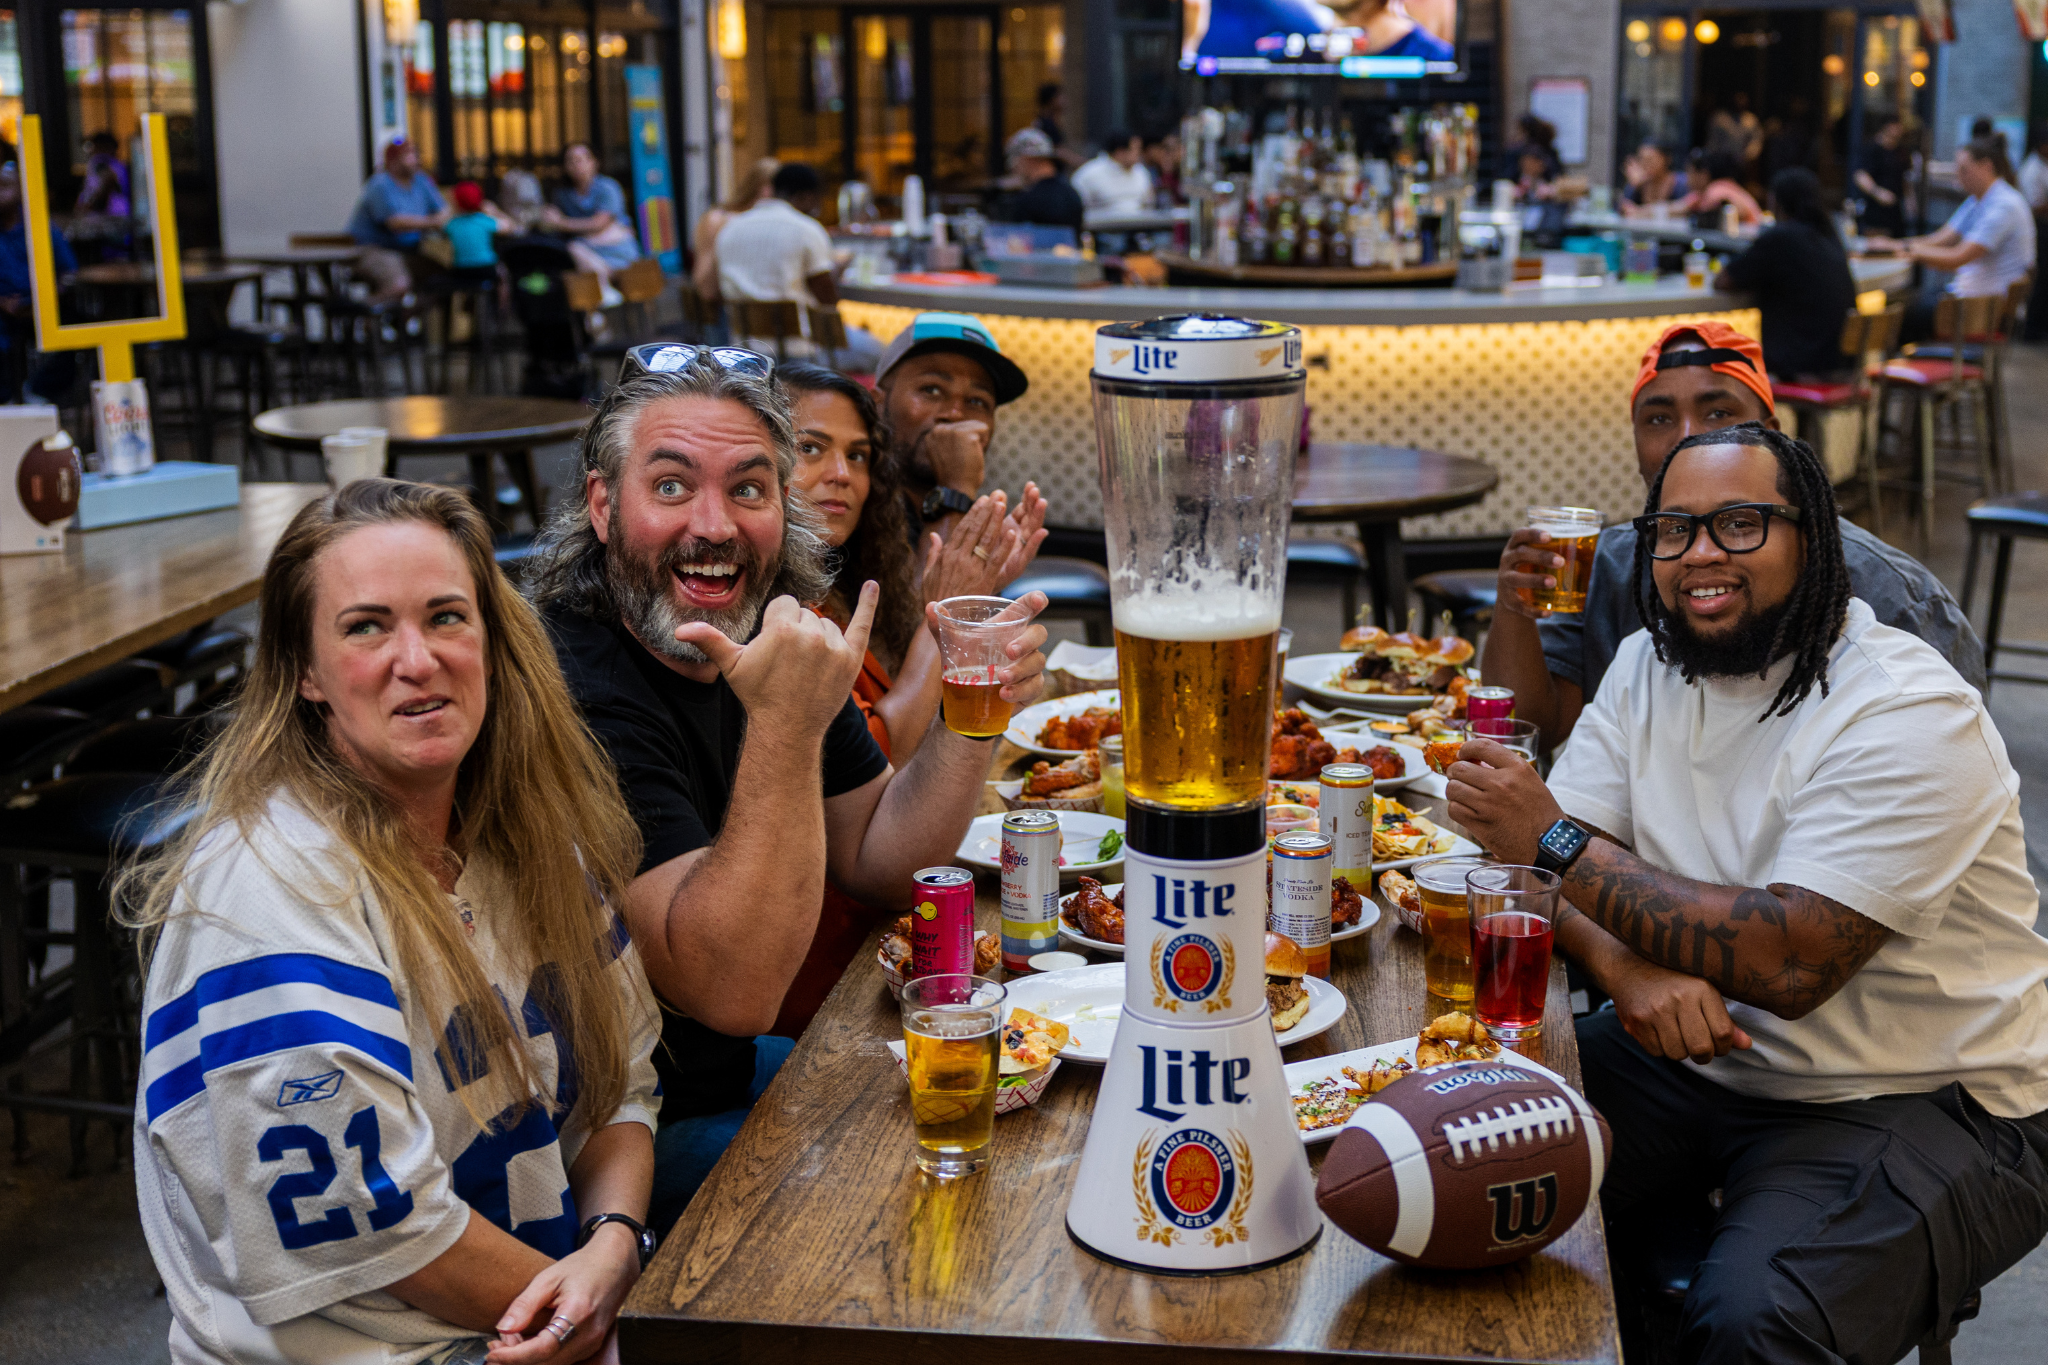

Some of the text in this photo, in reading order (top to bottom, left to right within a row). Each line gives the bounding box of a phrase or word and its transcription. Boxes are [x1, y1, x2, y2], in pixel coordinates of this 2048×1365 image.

[1133, 344, 1177, 375] Lite
[1276, 881, 1323, 892] STATESIDE
[1283, 893, 1314, 901] VODKA
[1151, 874, 1235, 929] Lite
[916, 930, 938, 942] WHY
[913, 942, 941, 957] WAIT
[1136, 1045, 1251, 1123] Lite
[1154, 1131, 1232, 1172] A FINE PILSNER
[257, 1105, 414, 1250] 21
[1174, 1213, 1213, 1227] BEER
